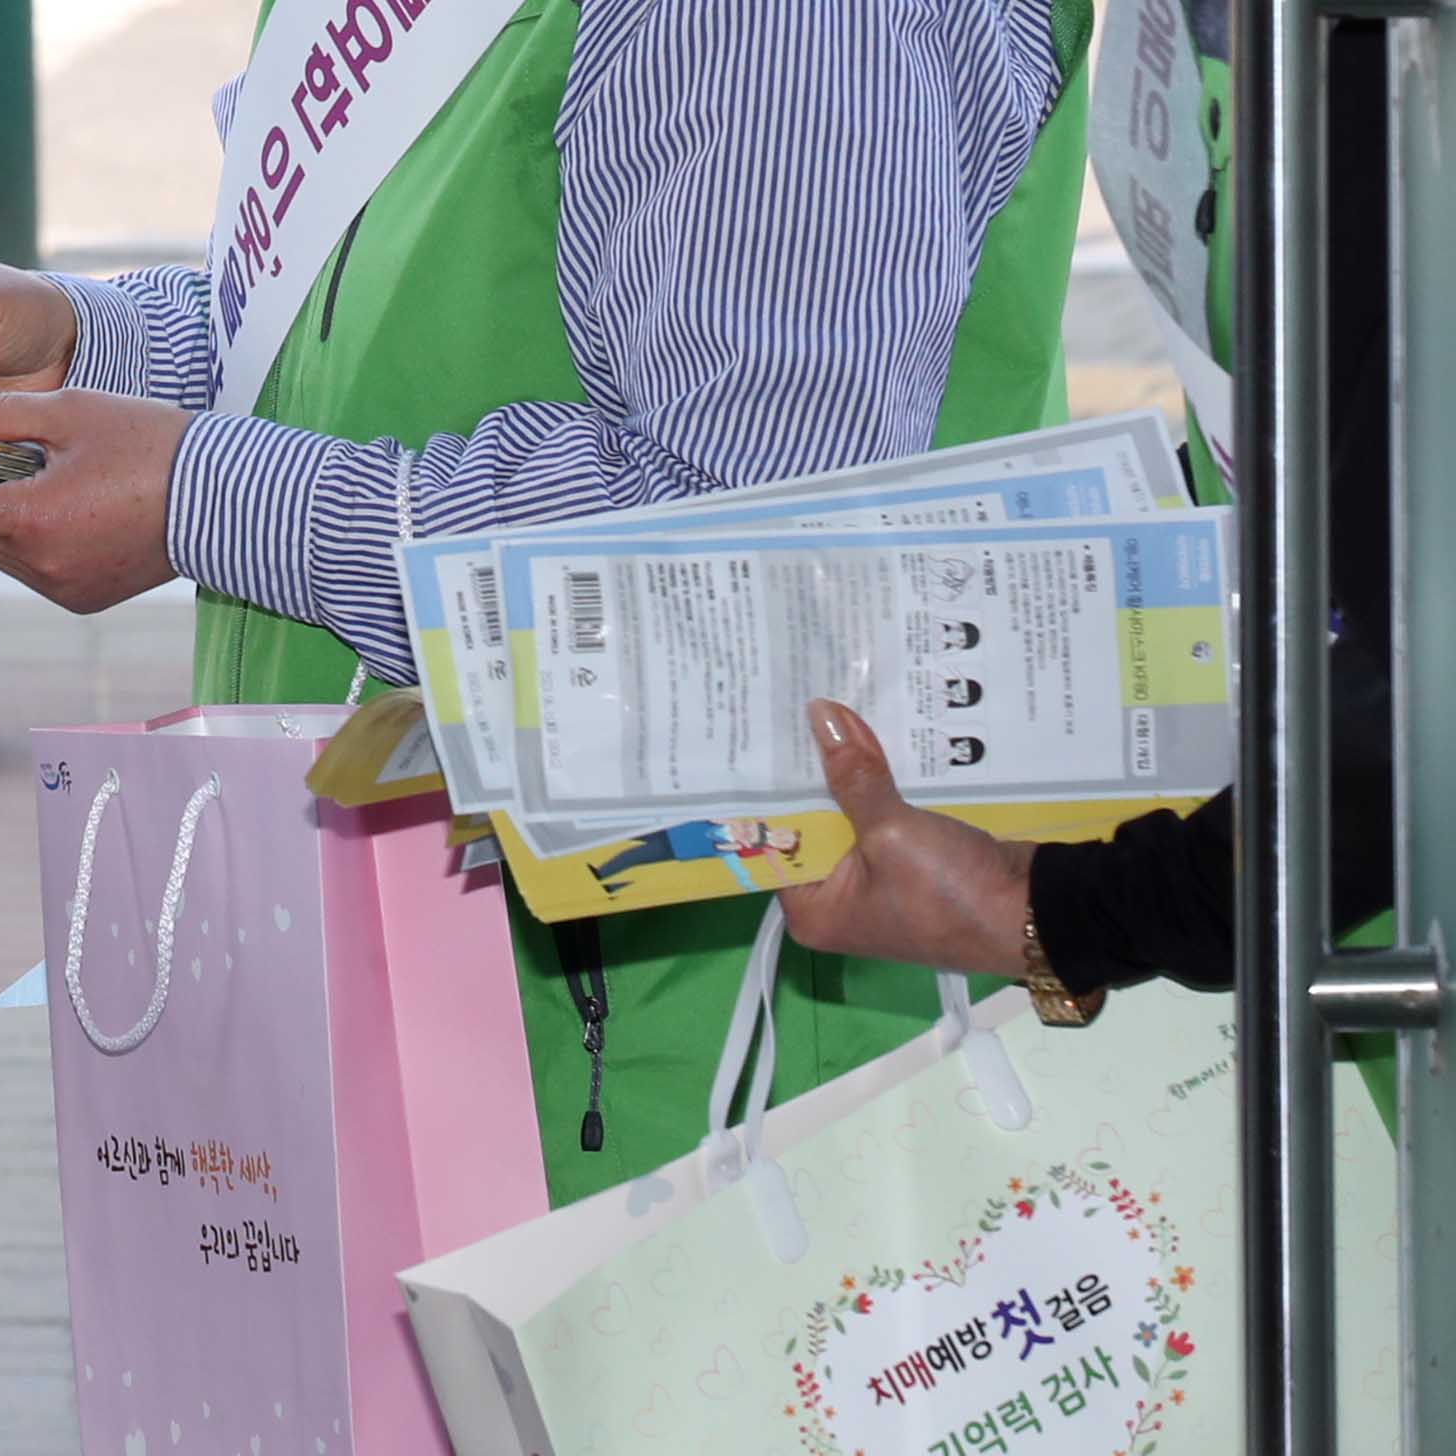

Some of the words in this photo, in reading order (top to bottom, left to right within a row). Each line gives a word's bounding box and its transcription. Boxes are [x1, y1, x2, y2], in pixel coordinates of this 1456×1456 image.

[97, 1135, 152, 1181] 어르신과
[154, 1135, 186, 1186] 함께
[191, 1139, 234, 1195] 행복한
[200, 1223, 240, 1265] 우리의
[243, 1219, 301, 1273] 꿈입니다
[867, 1316, 993, 1407] 치매예방
[1040, 1345, 1120, 1417] 검사
